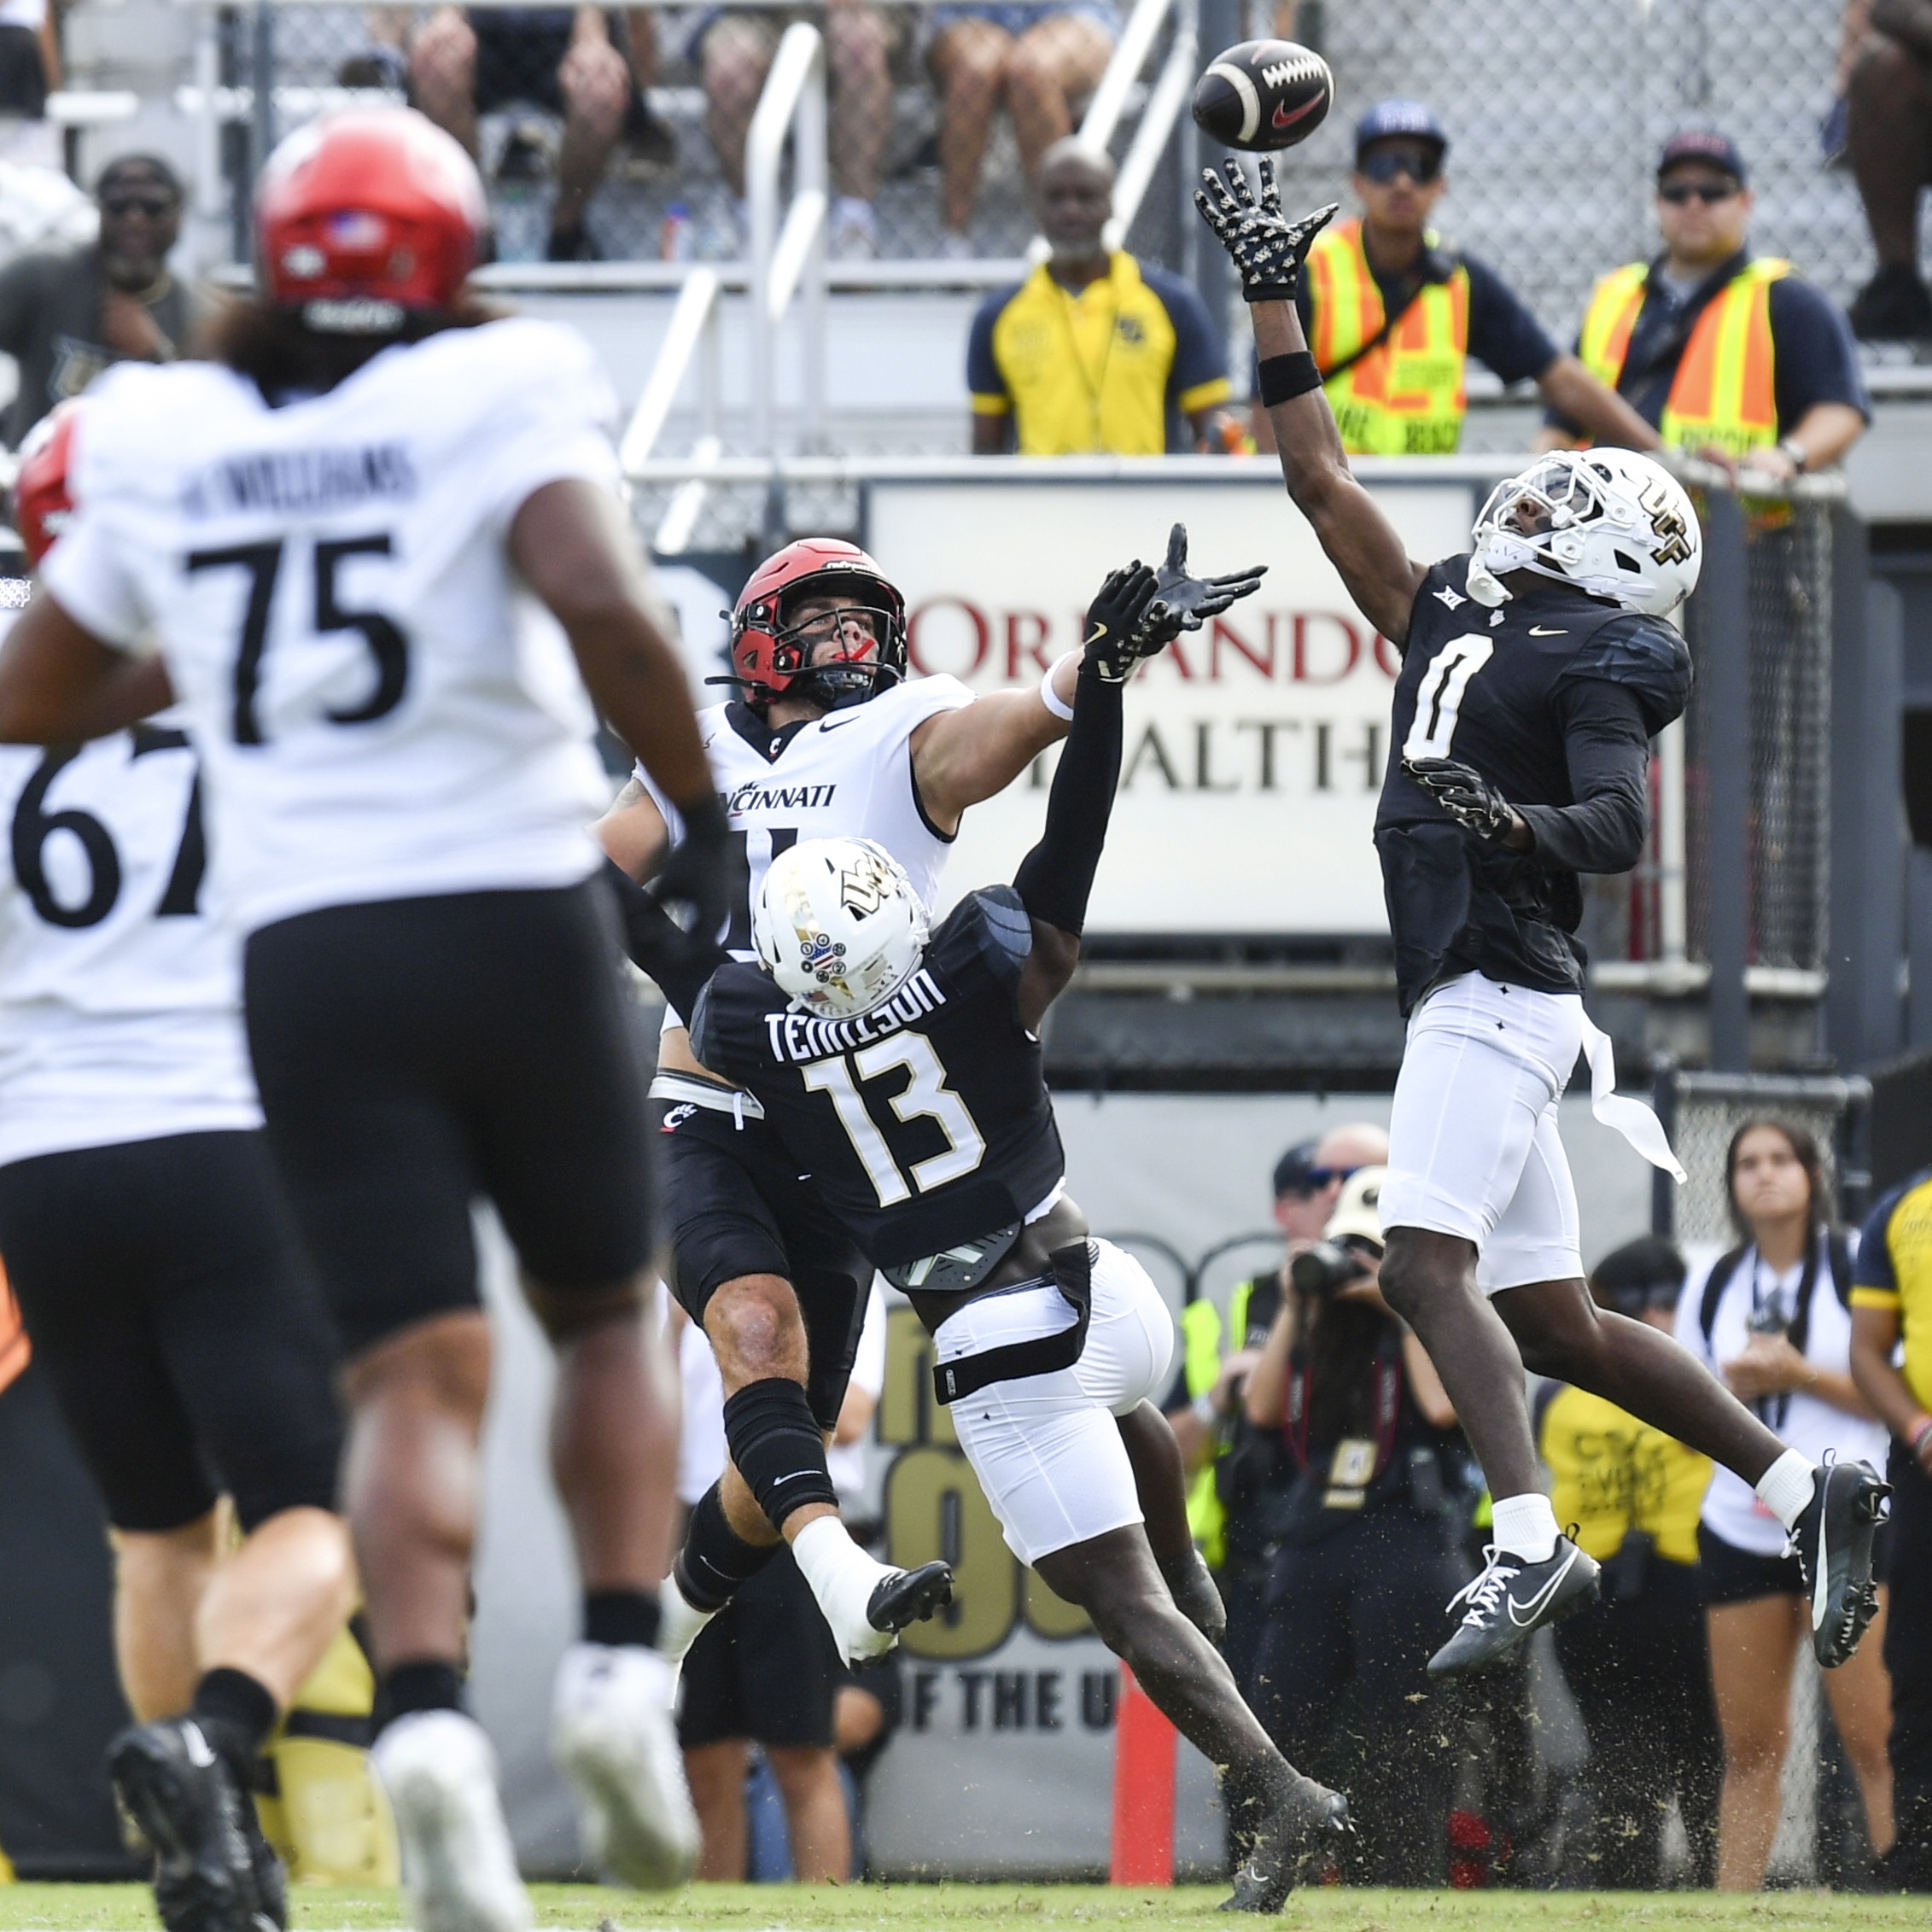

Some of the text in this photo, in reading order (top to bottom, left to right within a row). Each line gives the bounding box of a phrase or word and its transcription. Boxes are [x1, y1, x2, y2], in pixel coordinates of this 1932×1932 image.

[185, 531, 409, 746] 75
[907, 597, 1404, 683] ORND
[1402, 633, 1494, 759] 0
[1027, 719, 1390, 791] ALTH
[12, 727, 206, 928] 67
[799, 1029, 987, 1208] 13
[956, 1672, 1060, 1731] THE
